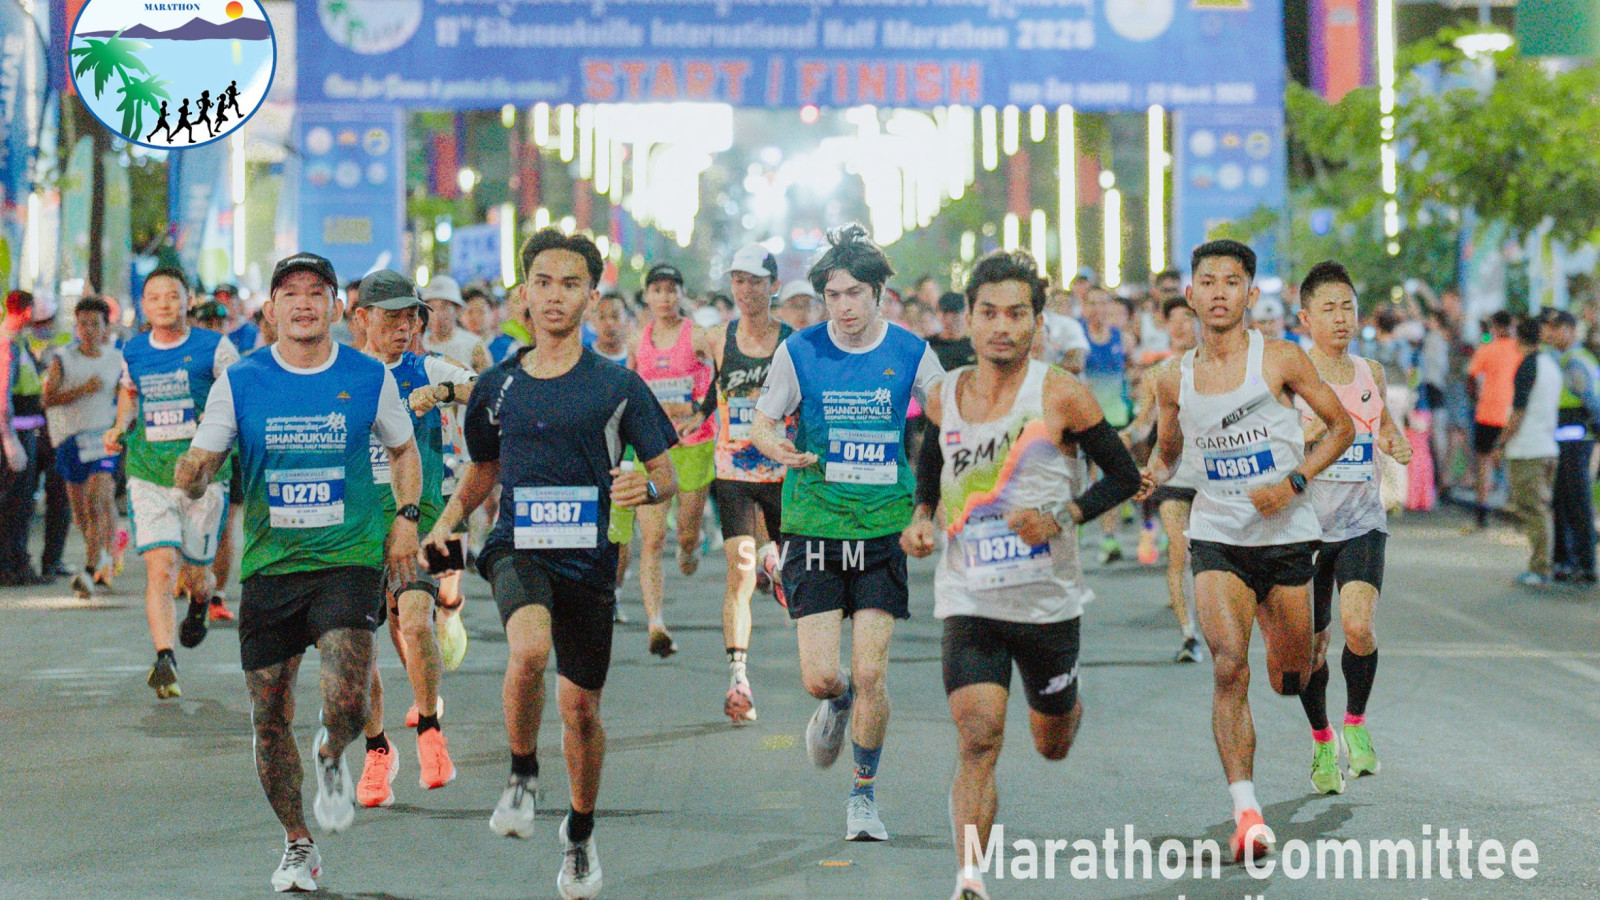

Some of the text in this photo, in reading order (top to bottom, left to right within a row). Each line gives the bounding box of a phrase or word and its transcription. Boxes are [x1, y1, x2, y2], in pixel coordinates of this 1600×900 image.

[651, 18, 817, 48] International
[823, 19, 877, 48] Half
[882, 20, 1010, 48] Marathon
[583, 60, 750, 100] START
[799, 60, 983, 101] FINISH
[153, 410, 184, 425] 0357
[823, 406, 892, 415] SIHANOUKVILLE
[265, 433, 347, 445] SIHANOUKVILLE
[1195, 426, 1268, 450] GARMIN
[843, 442, 886, 462] 0144
[1216, 455, 1260, 478] 0361
[282, 482, 331, 504] 0279
[530, 502, 582, 523] 0387
